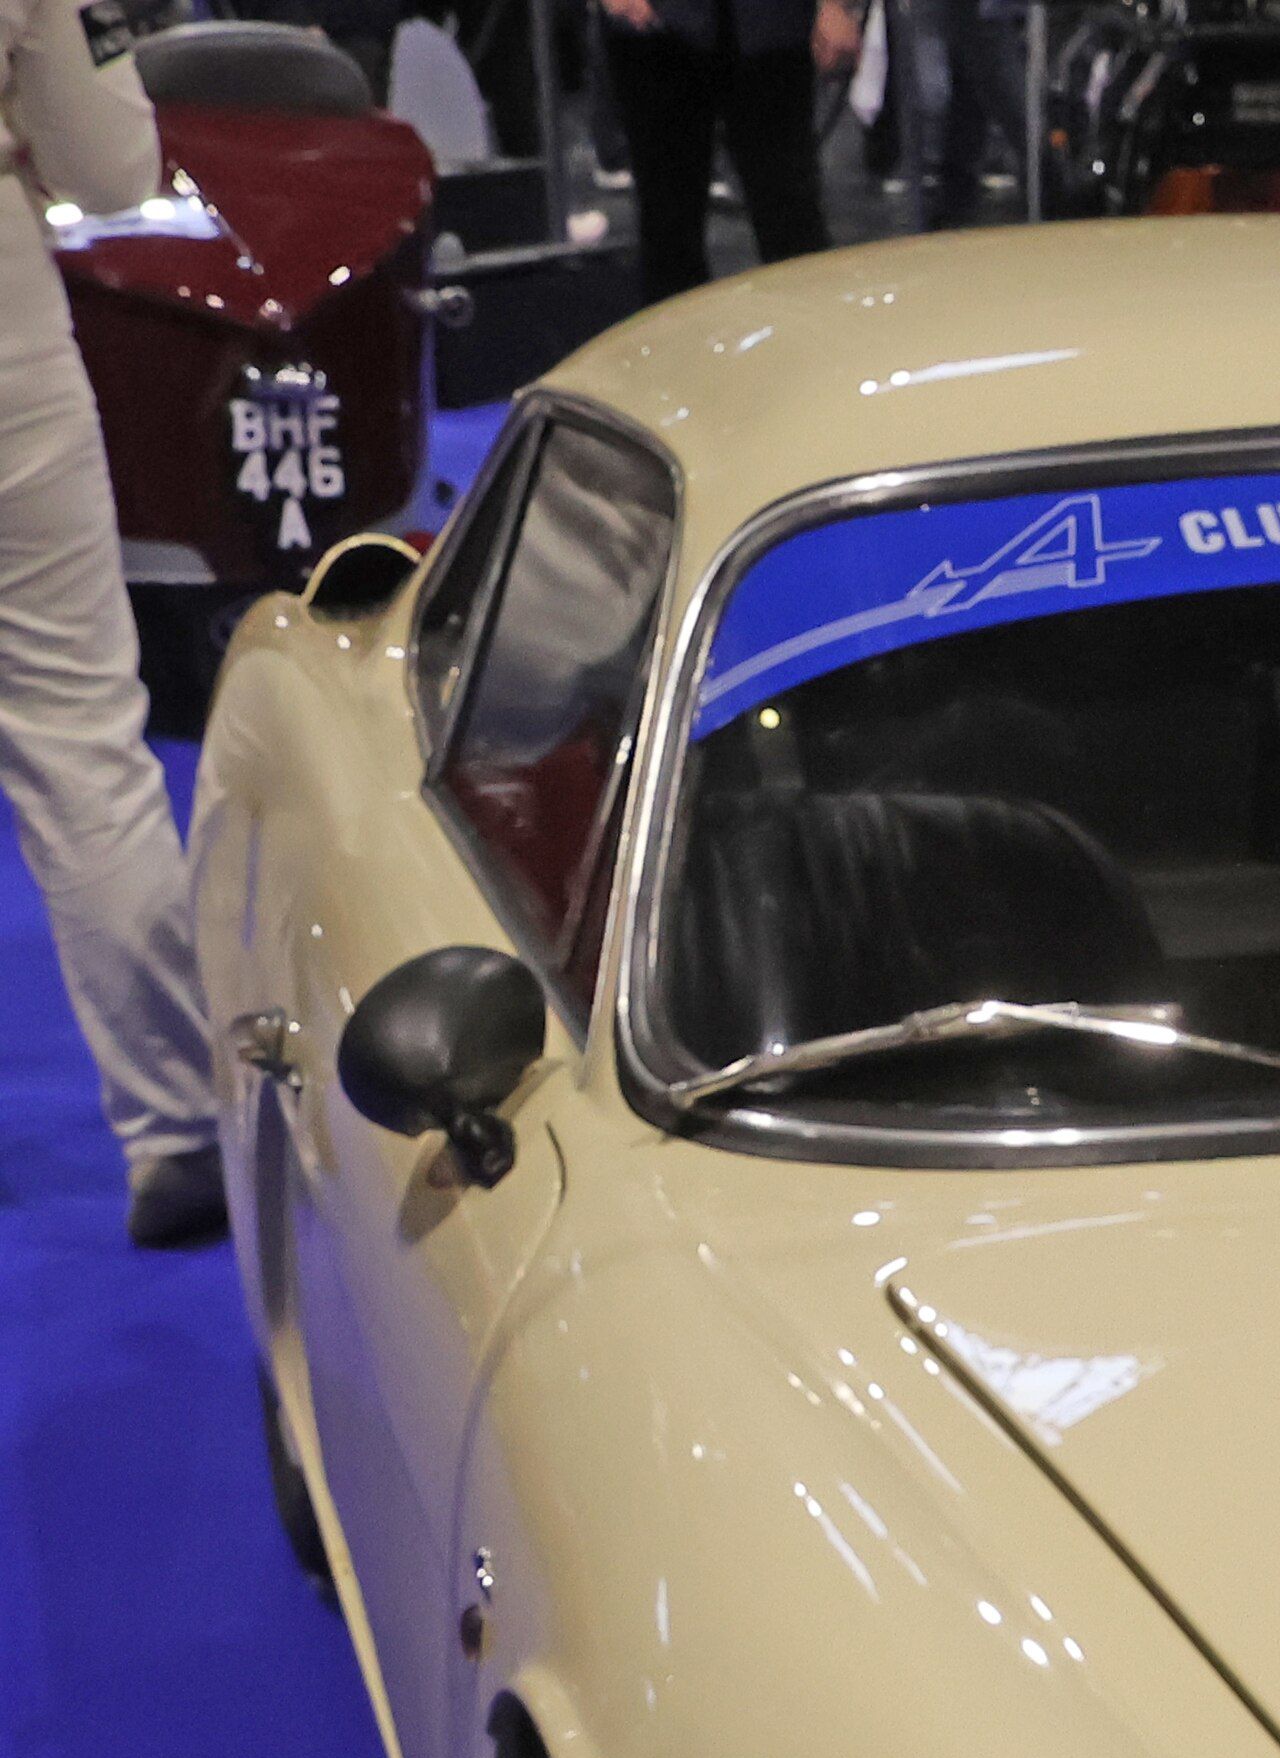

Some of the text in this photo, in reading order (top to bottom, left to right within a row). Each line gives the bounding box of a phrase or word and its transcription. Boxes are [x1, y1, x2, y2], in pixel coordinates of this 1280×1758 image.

[229, 395, 340, 452] BHF
[236, 447, 345, 501] 446
[277, 496, 312, 549] A
